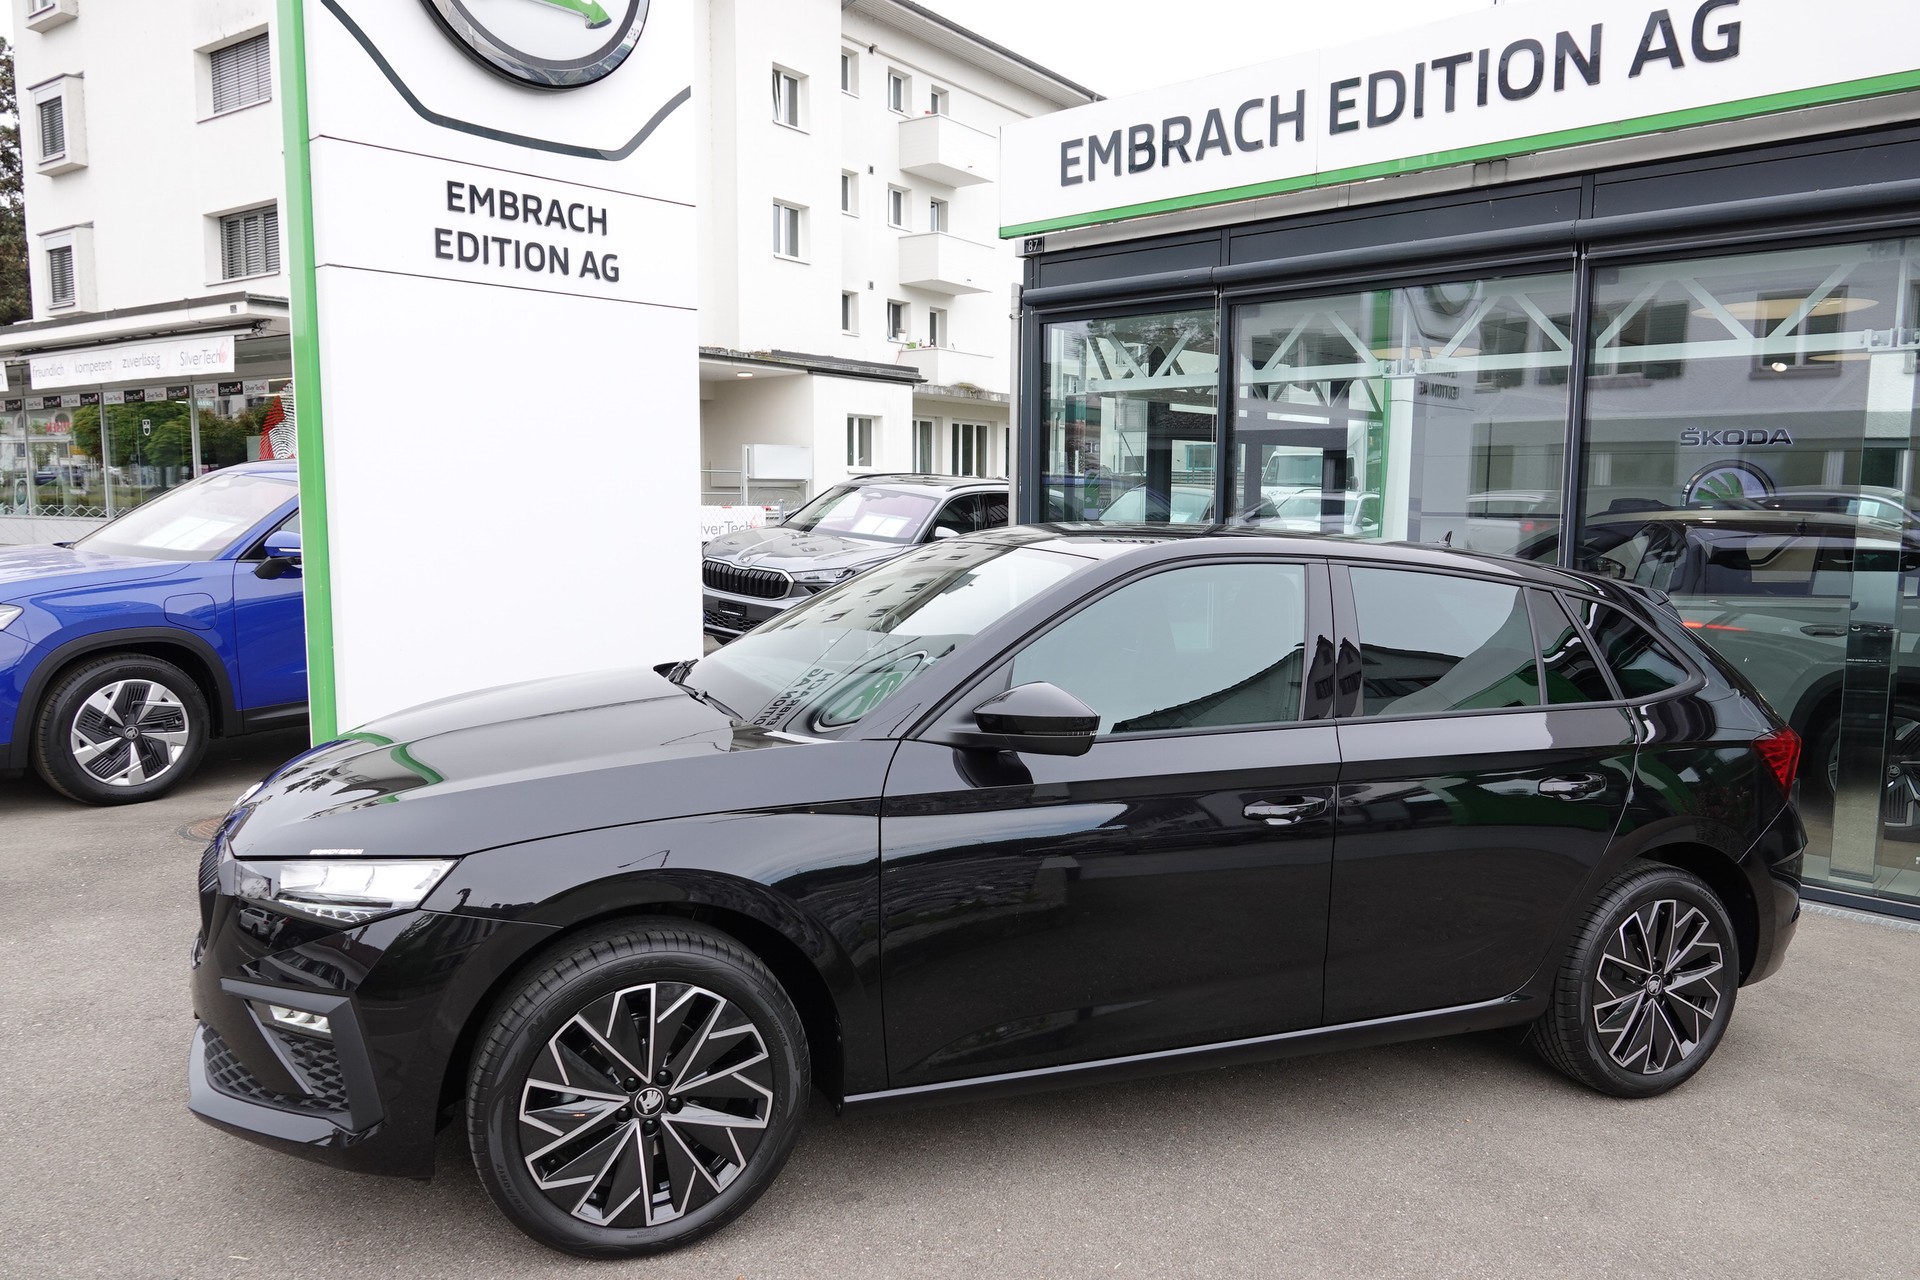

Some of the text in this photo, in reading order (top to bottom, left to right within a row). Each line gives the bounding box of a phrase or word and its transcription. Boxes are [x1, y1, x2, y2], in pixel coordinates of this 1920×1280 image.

[1060, 0, 1742, 187] EMBRACH EDITION AG
[446, 180, 607, 236] EMBRACH
[435, 227, 620, 283] EDITION AG
[1028, 239, 1039, 252] 87
[32, 364, 65, 379] freundlich
[74, 359, 112, 375] kompetent
[179, 348, 221, 367] SilverTech
[1680, 427, 1793, 447] ŠKODA
